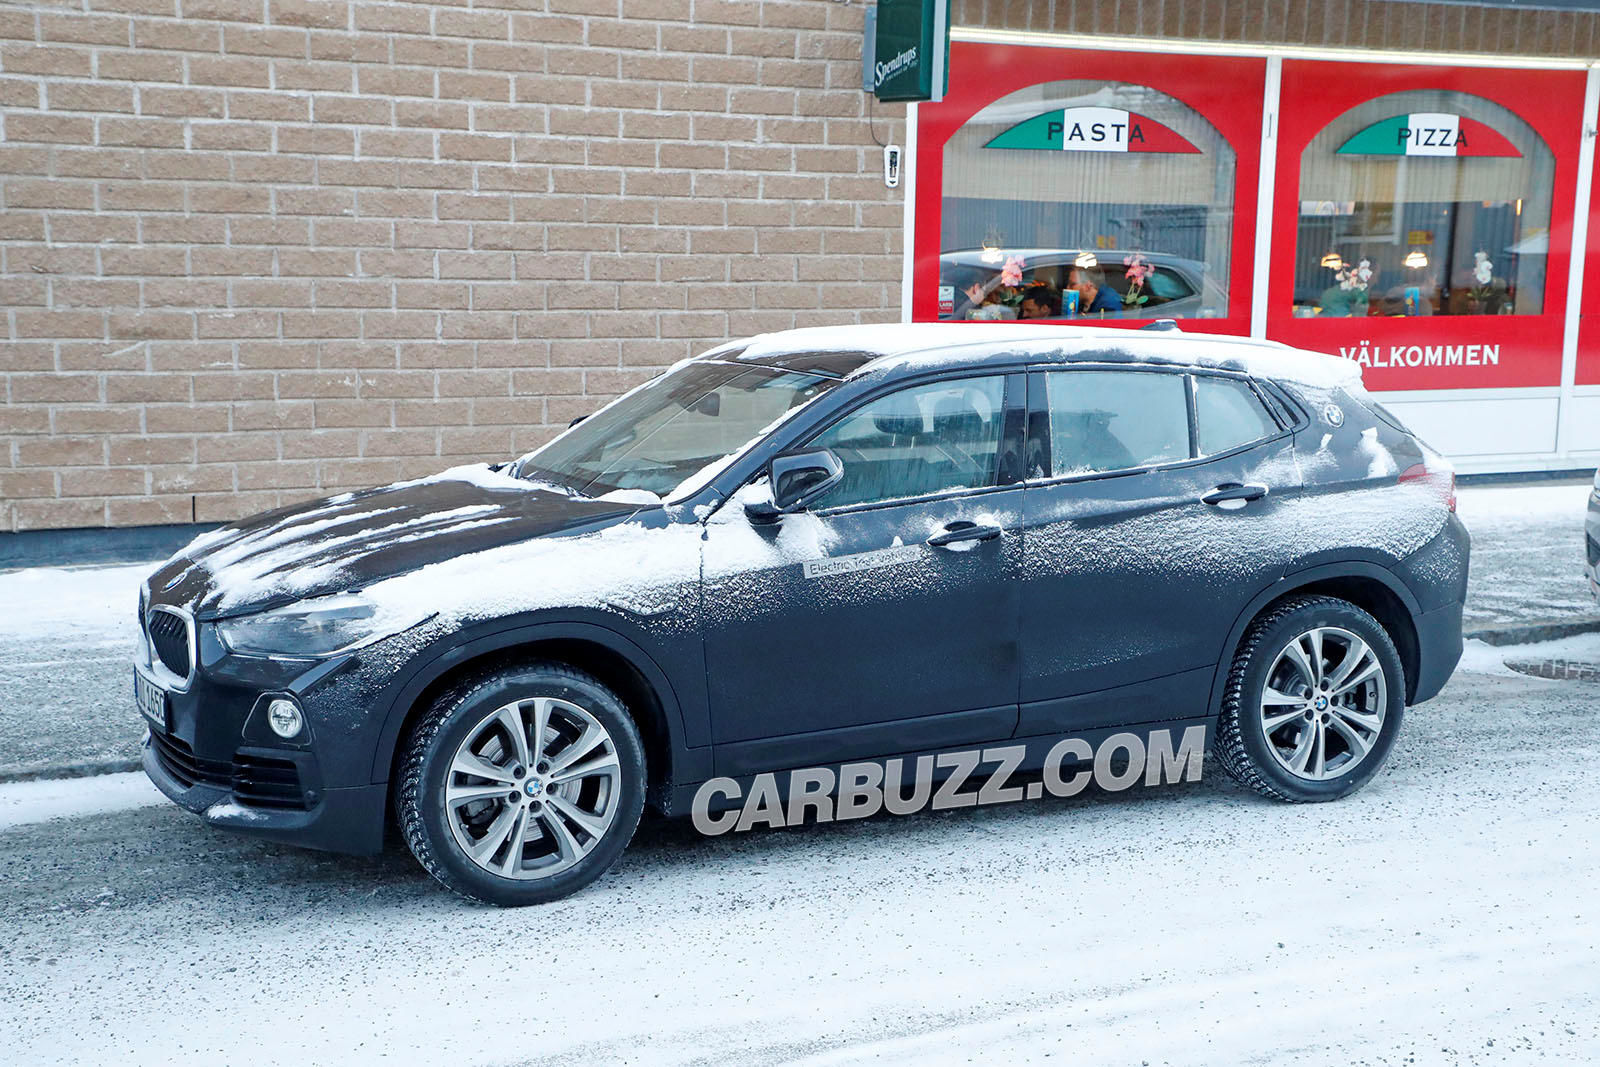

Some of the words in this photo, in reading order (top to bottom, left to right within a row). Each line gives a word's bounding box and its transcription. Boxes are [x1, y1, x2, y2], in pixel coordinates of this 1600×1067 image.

[875, 46, 917, 87] Spendrups
[1047, 121, 1145, 143] PASTA
[1397, 127, 1469, 147] PIZZA
[1339, 340, 1500, 368] VÄLKOMMEN
[809, 558, 850, 576] Electric
